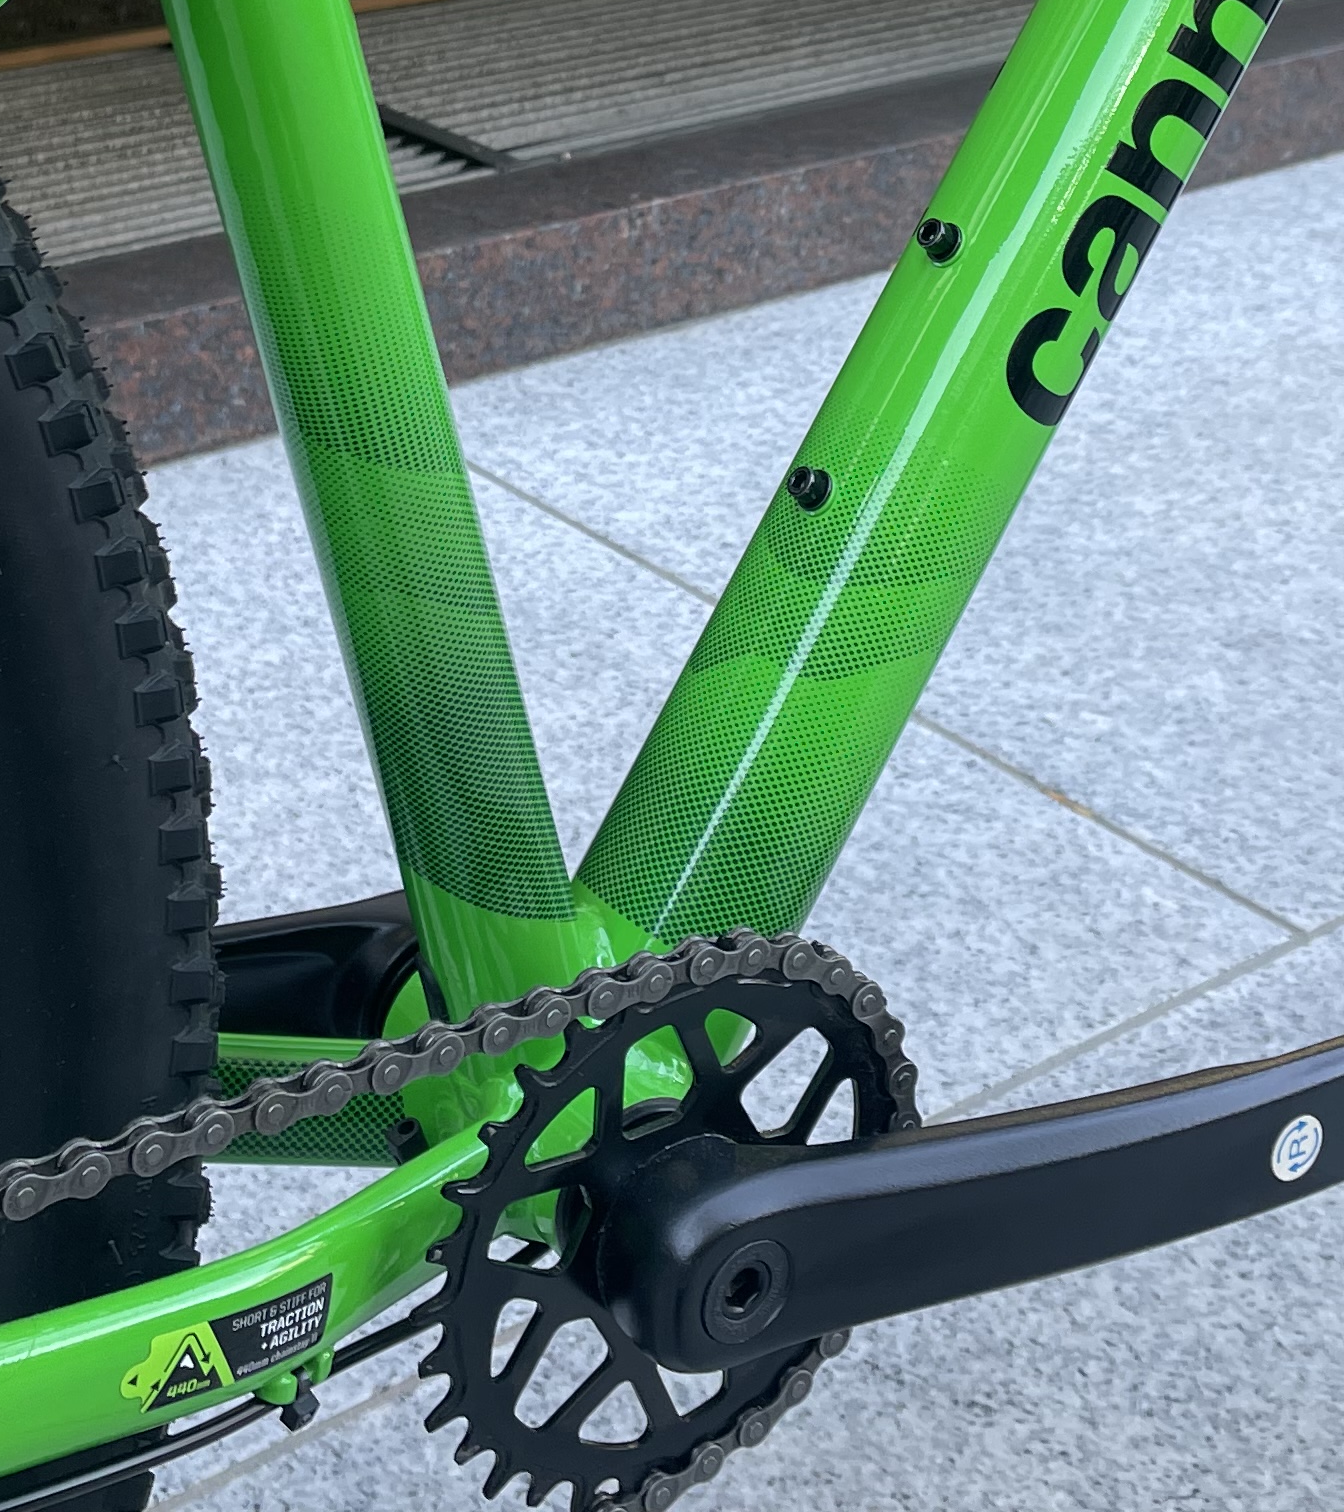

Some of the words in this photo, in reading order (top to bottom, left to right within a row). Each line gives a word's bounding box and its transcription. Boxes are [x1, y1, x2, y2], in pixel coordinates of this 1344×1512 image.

[1289, 1135, 1309, 1160] R
[232, 1308, 267, 1331] SHORT
[279, 1292, 307, 1313] STIFF
[308, 1281, 327, 1300] FOR
[260, 1296, 325, 1337] TRACTION
[269, 1313, 323, 1350] AGILITY
